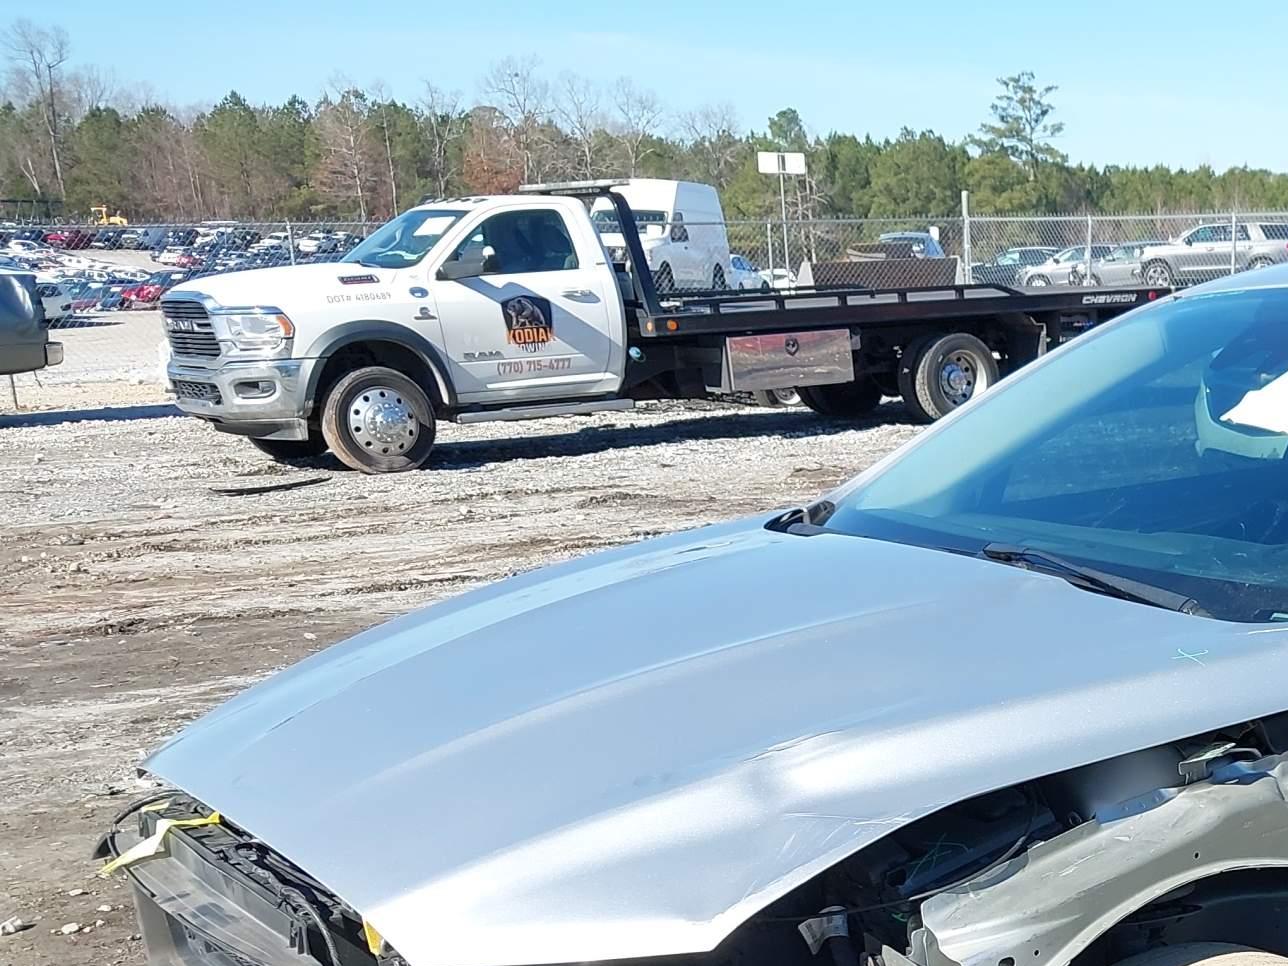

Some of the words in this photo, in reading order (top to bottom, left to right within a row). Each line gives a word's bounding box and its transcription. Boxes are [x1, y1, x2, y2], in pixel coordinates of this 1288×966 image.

[326, 294, 352, 304] DOT#
[1081, 293, 1138, 305] CHEVRON
[463, 350, 505, 361] RAM
[496, 361, 524, 376] (770)
